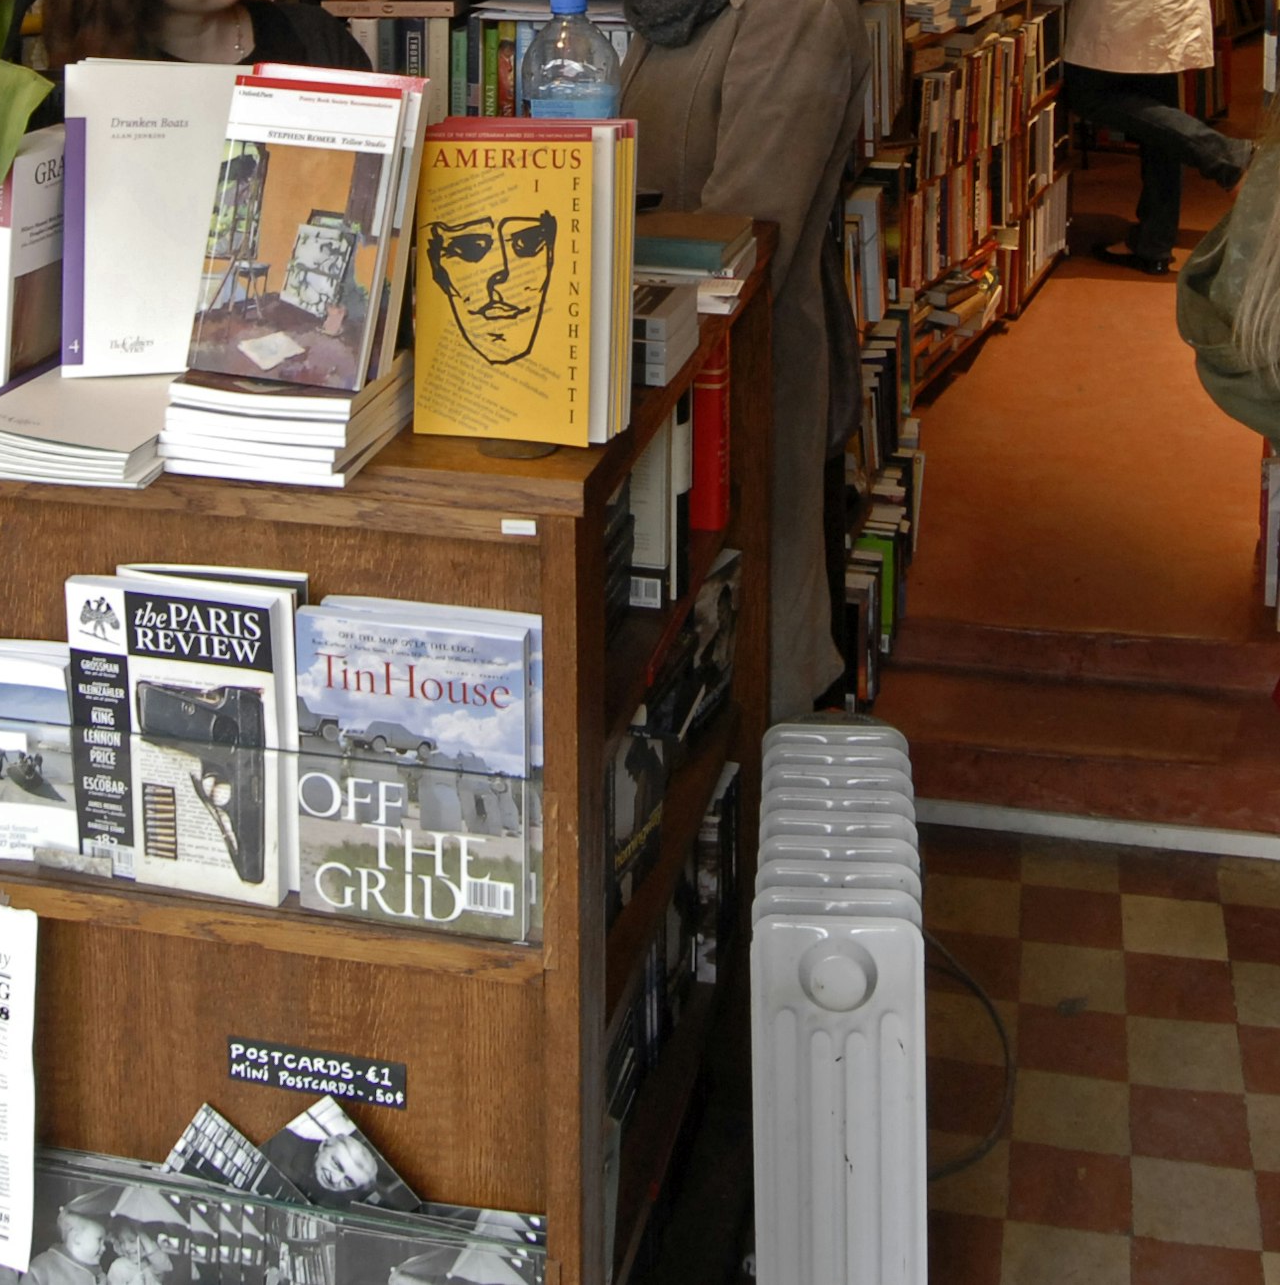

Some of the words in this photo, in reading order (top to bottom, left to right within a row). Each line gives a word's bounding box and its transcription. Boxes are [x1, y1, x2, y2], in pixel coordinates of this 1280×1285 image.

[110, 117, 158, 129] Drunken
[160, 117, 189, 129] Boats
[267, 130, 305, 141] STEPHEN
[307, 134, 336, 144] ROMER
[340, 137, 363, 146] Yellow
[364, 138, 387, 148] Studio
[433, 147, 583, 170] AMERICUS
[567, 176, 582, 425] FERLINGHETTI
[69, 339, 80, 354] 4
[133, 601, 167, 629] the
[167, 601, 263, 641] PARIS
[134, 627, 262, 664] REVIEW
[314, 652, 376, 695] Tin
[383, 661, 511, 710] House
[91, 710, 115, 725] KING
[83, 729, 121, 746] LENNON
[90, 749, 116, 766] PRICE
[298, 771, 405, 825] OFF
[361, 823, 492, 882] THE
[314, 861, 464, 922] GRID
